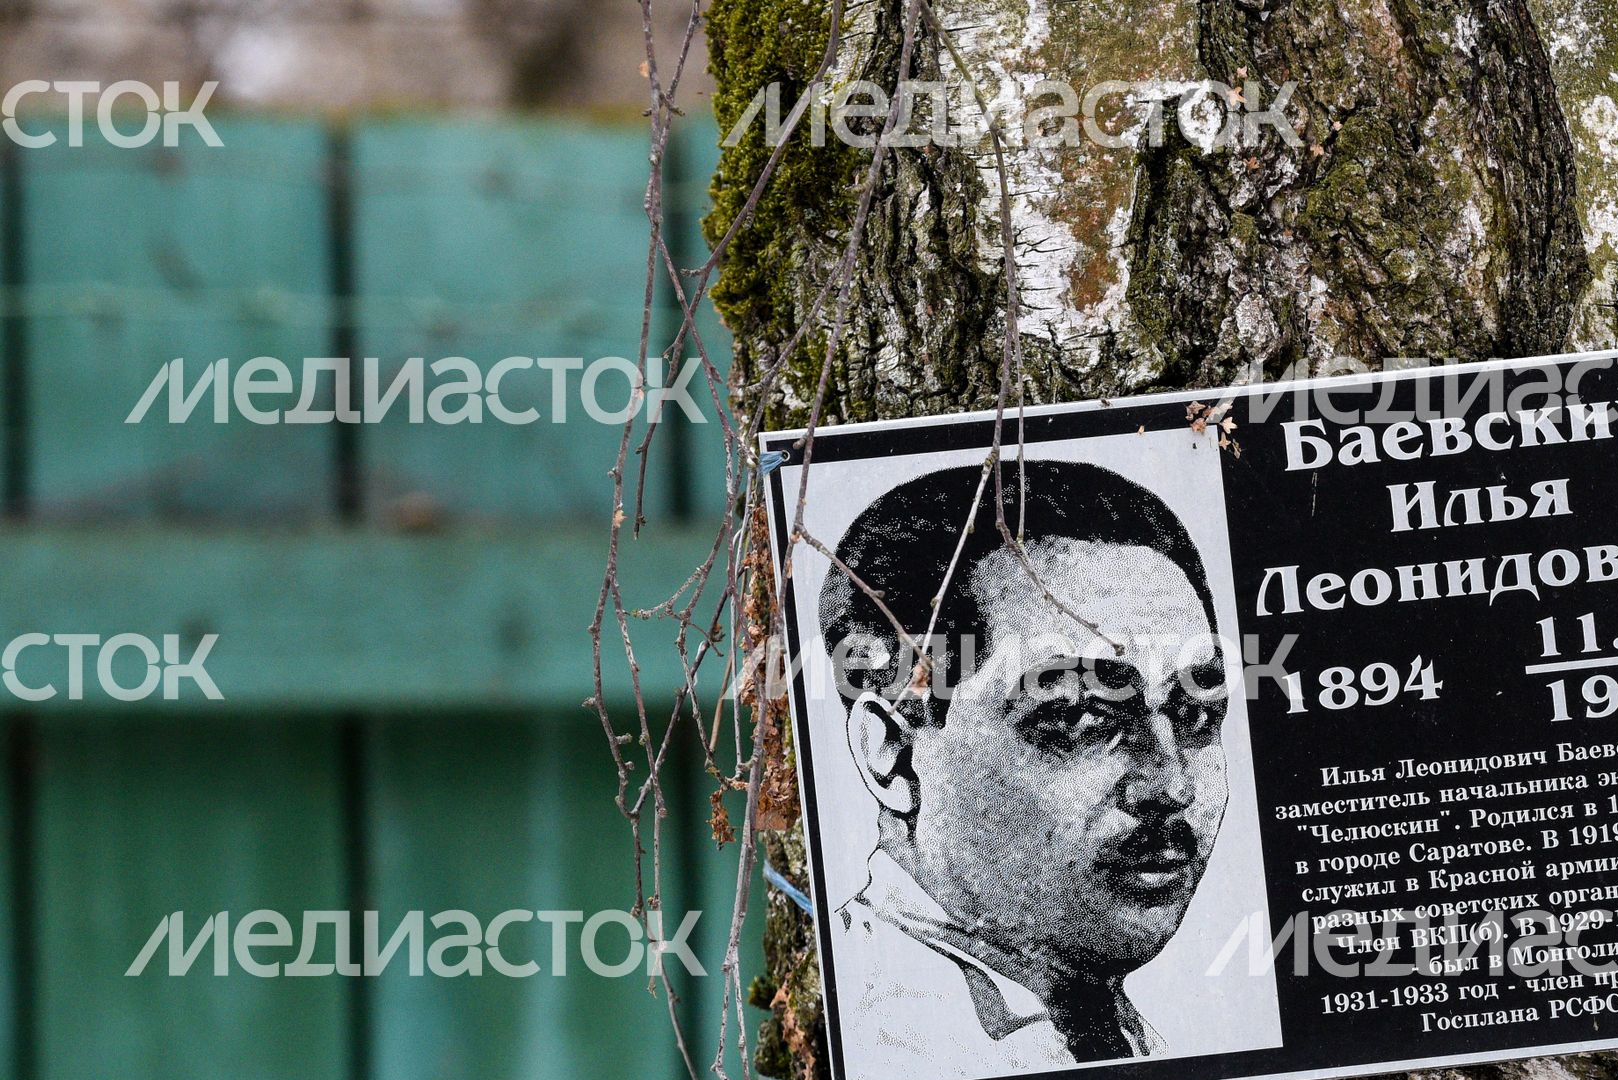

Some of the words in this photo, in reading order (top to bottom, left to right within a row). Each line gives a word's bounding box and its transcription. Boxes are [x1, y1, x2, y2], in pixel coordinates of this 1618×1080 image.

[1386, 477, 1574, 533] Илья
[1283, 654, 1444, 714] 1894
[1321, 766, 1385, 787] Илья
[1395, 750, 1547, 779] Леонидович
[1275, 791, 1431, 820] заместитель
[1439, 775, 1589, 803] начальника
[1469, 804, 1575, 829] Родился
[1583, 802, 1598, 816] в
[1295, 861, 1309, 875] в
[1318, 851, 1401, 874] городе
[1409, 838, 1532, 865] Саратове.
[1540, 829, 1559, 849] В
[1301, 880, 1397, 904] служил
[1405, 878, 1420, 892] в
[1428, 865, 1536, 892] Красной
[1311, 907, 1406, 935] разных
[1414, 893, 1540, 920] советских
[1335, 935, 1400, 955] Член
[1409, 920, 1508, 948] ВКП(б).
[1516, 917, 1536, 937] В
[1428, 955, 1479, 975] был
[1488, 954, 1503, 969] в
[1321, 982, 1449, 1014] 1931-1933
[1458, 983, 1499, 1001] год
[1525, 974, 1584, 992] член
[1420, 1007, 1540, 1032] Госплана
